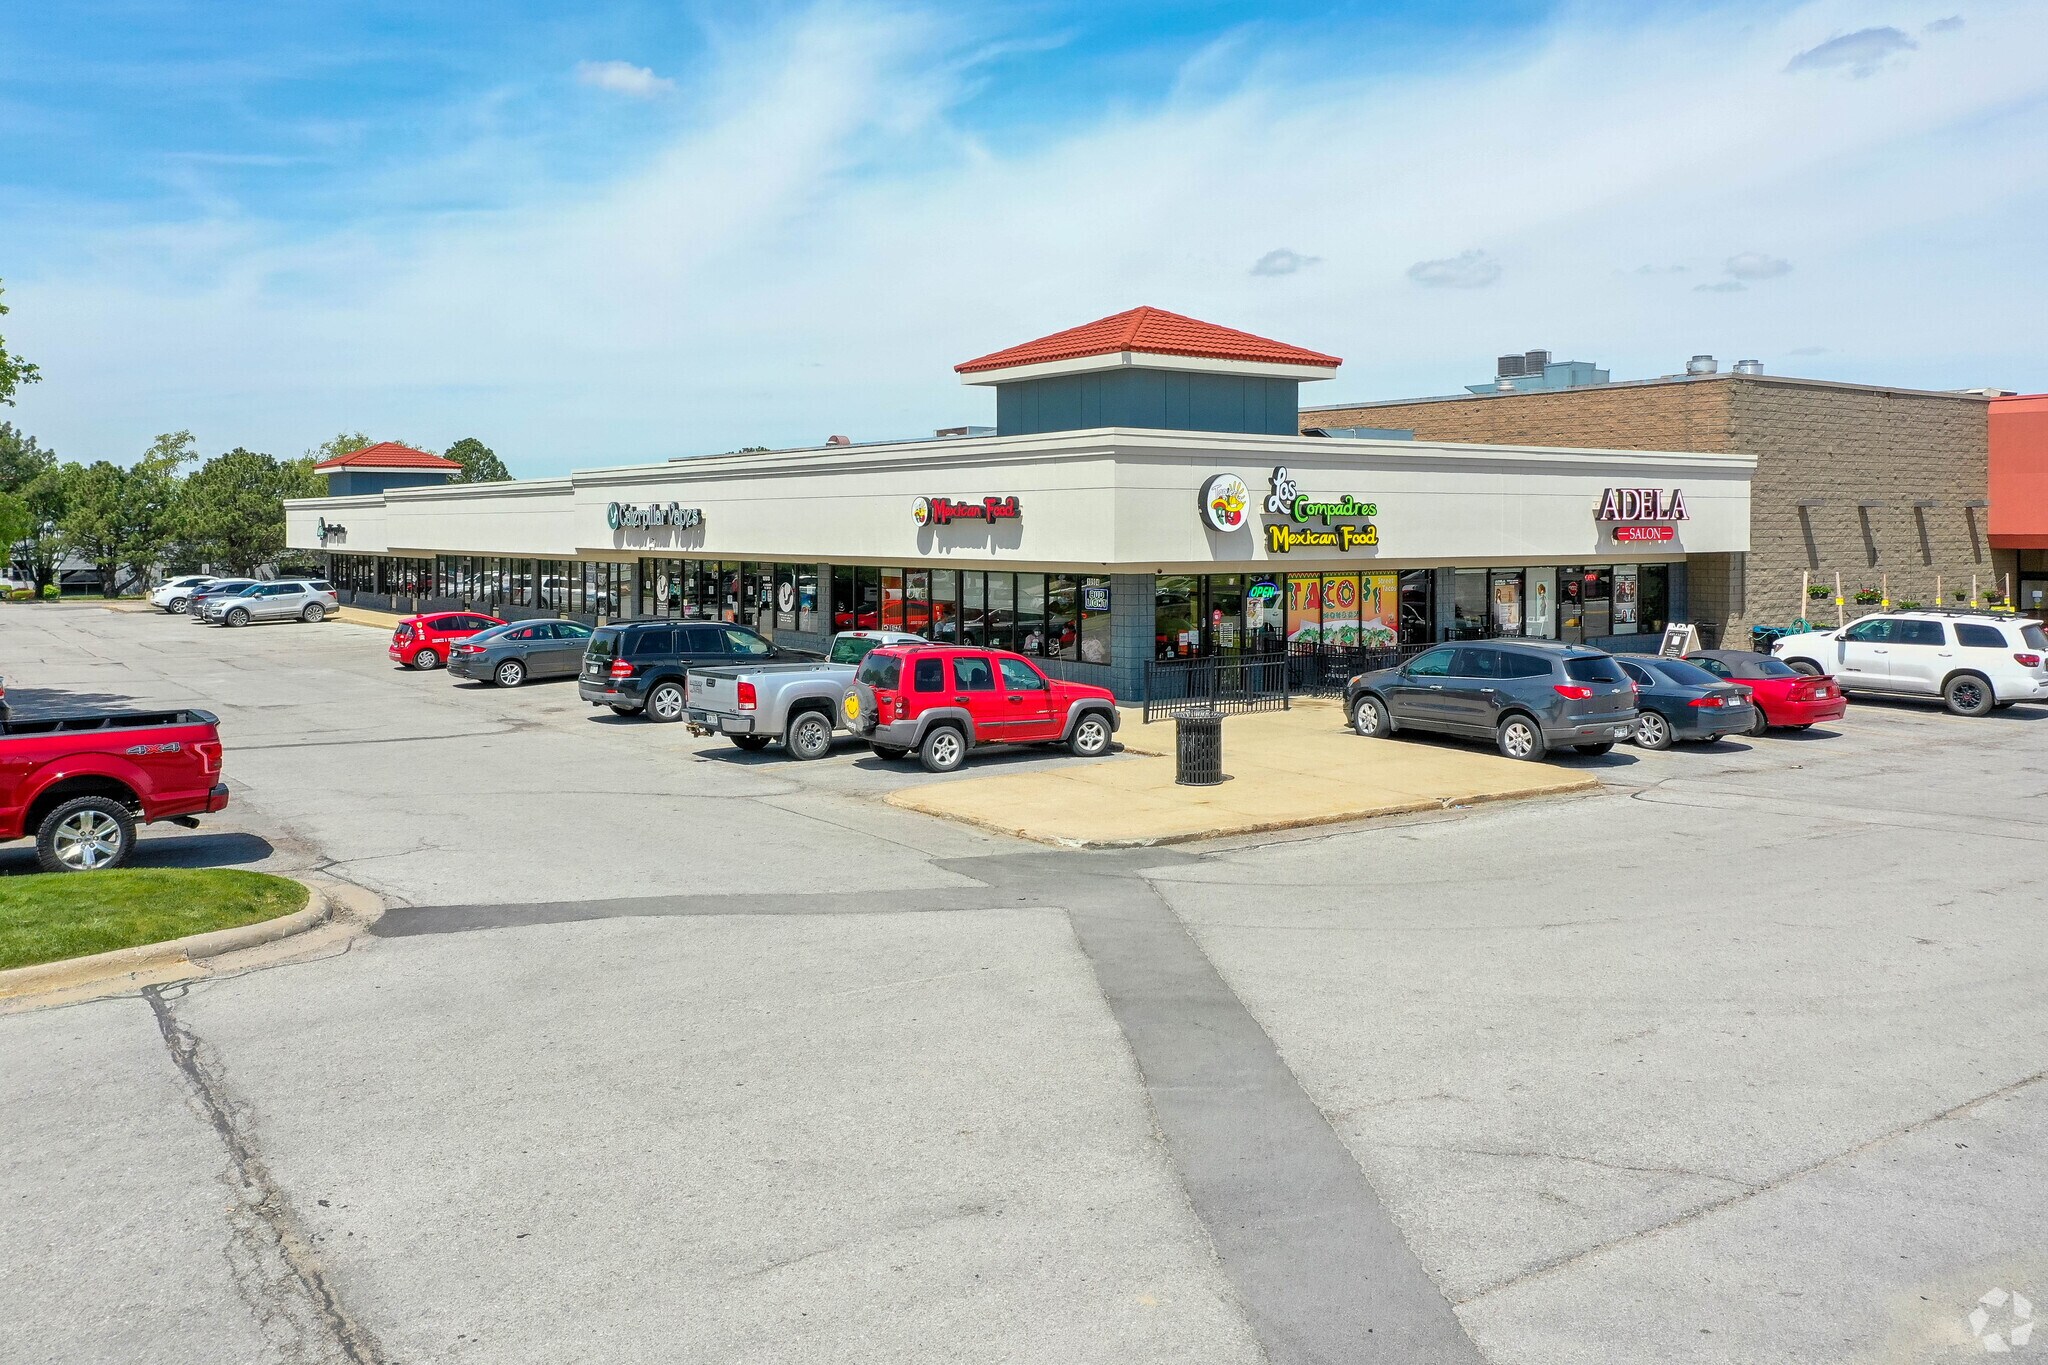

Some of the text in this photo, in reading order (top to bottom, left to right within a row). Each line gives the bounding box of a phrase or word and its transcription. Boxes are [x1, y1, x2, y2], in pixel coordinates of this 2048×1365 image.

[1268, 466, 1297, 514] Los
[619, 502, 699, 531] Caterpillar Vapes
[931, 496, 1018, 524] Mexican Food
[1293, 495, 1377, 525] Compadres
[1599, 488, 1689, 520] ADELA
[1269, 525, 1378, 552] Mexican Food
[1629, 527, 1662, 540] SALON
[1088, 590, 1105, 599] BUD
[1250, 586, 1275, 598] OPEN
[1378, 577, 1394, 585] Street
[1086, 598, 1107, 608] LIGHT
[1287, 579, 1356, 611] TACO
